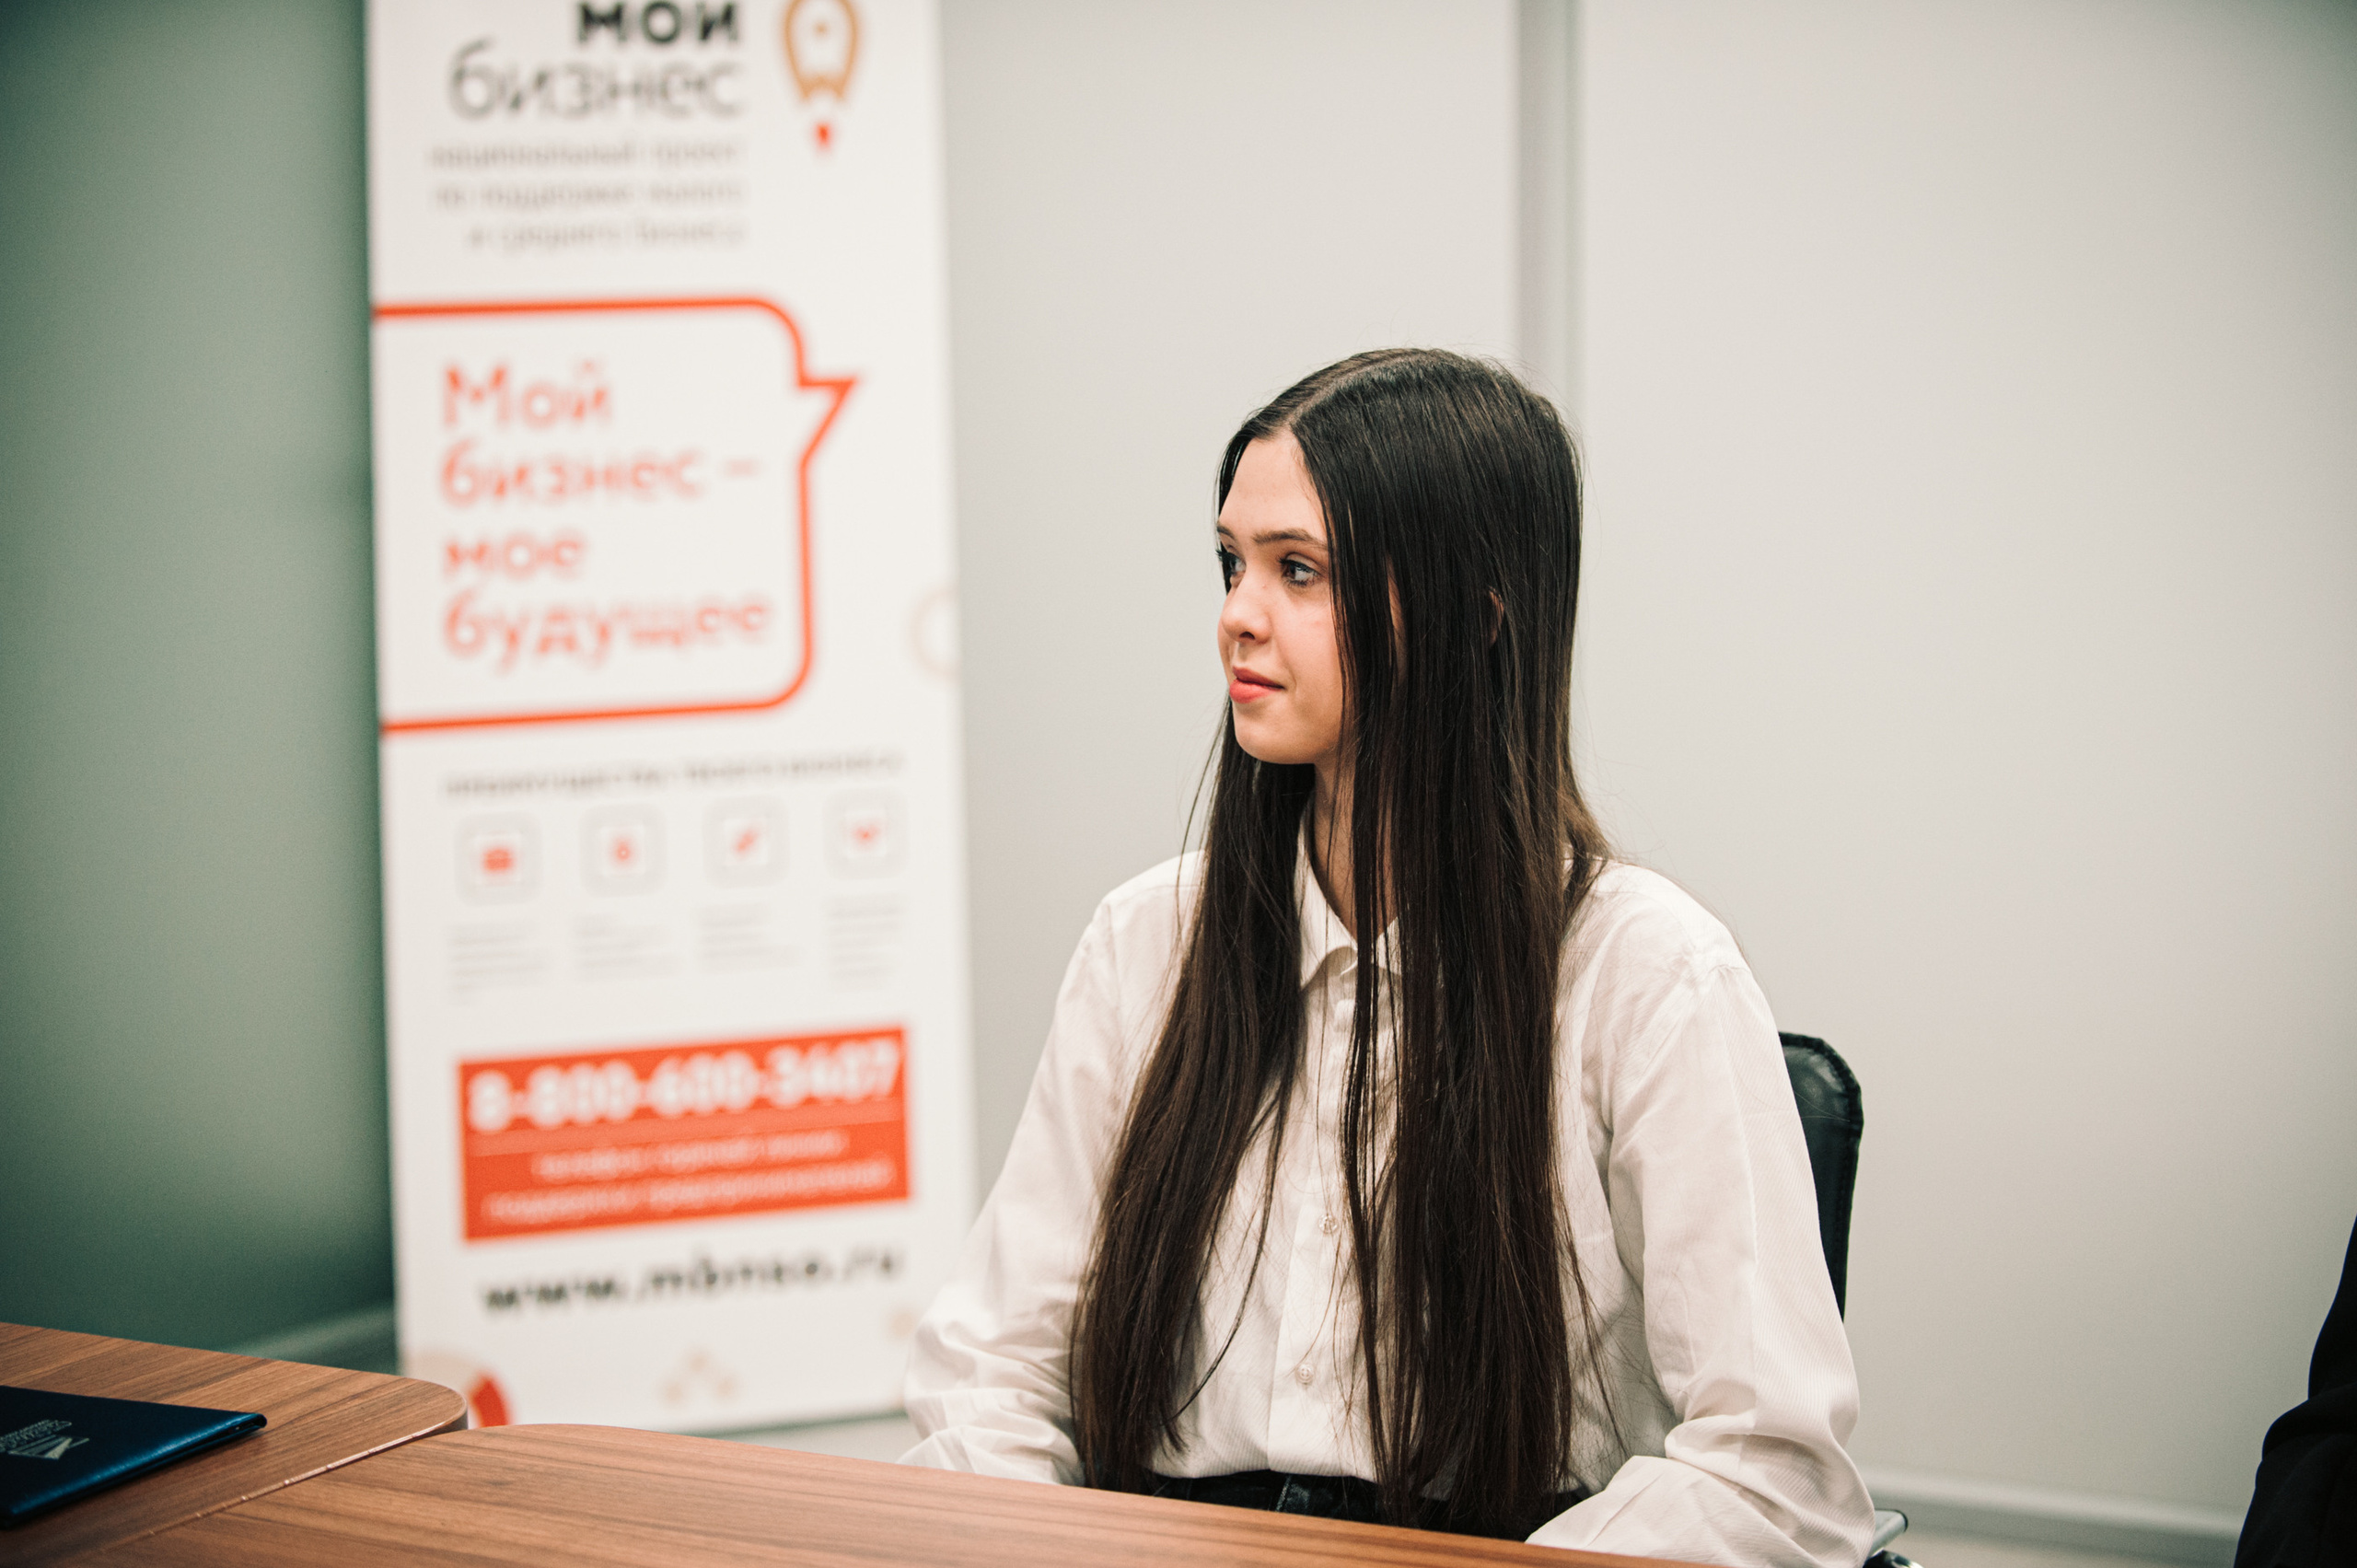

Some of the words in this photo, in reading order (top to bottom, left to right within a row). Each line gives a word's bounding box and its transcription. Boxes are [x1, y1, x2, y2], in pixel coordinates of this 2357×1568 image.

[448, 37, 746, 120] бизнес
[443, 359, 611, 428] Мой
[440, 437, 704, 508] бизнес
[442, 530, 586, 580] мое
[443, 587, 773, 678] будущее
[469, 1039, 899, 1130] 8-800-600-3407
